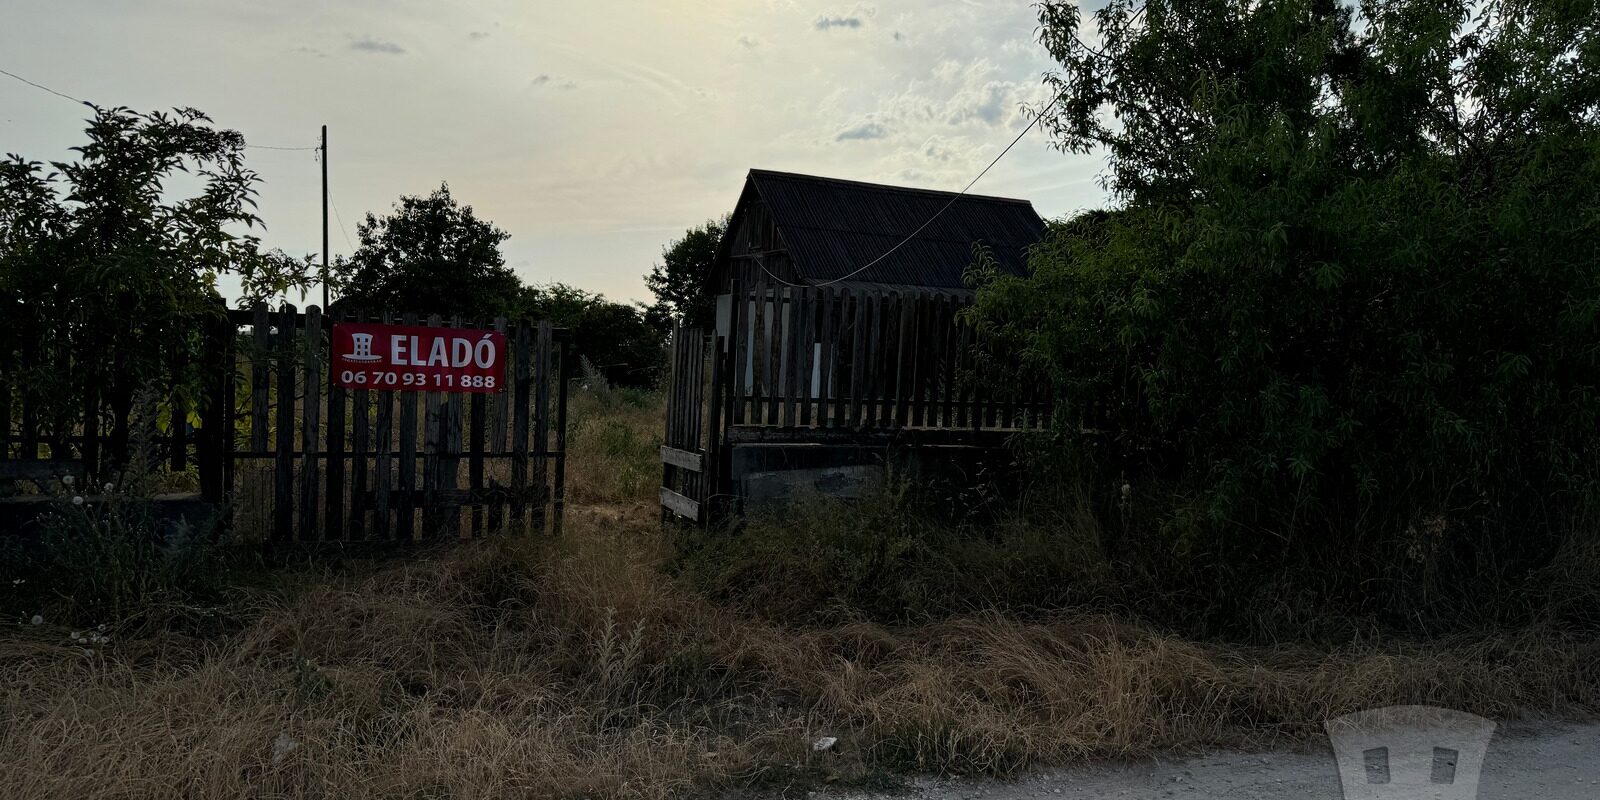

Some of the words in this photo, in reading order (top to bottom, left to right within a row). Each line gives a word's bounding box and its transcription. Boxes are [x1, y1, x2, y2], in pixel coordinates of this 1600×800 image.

[391, 333, 496, 369] ELADÓ
[341, 370, 367, 385] 06
[372, 371, 397, 385] 70
[402, 372, 426, 386] 93
[433, 373, 453, 387] 11
[460, 375, 496, 388] 888
